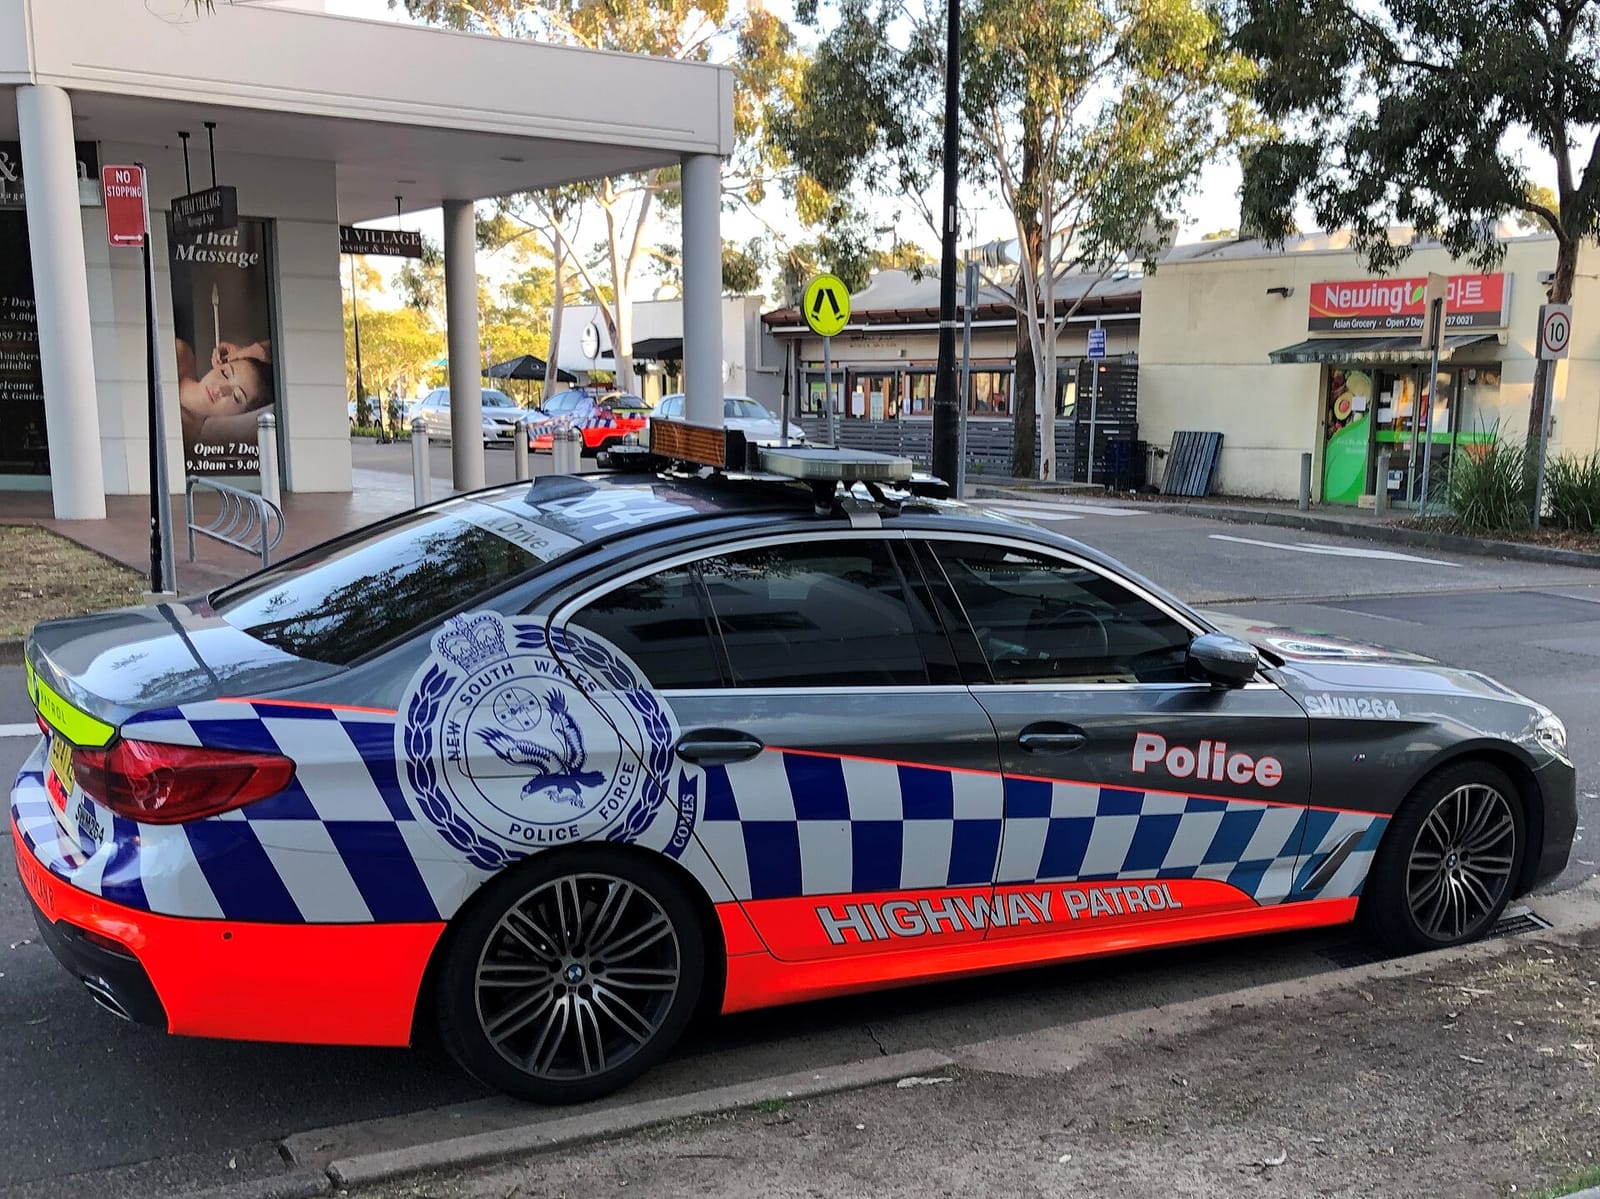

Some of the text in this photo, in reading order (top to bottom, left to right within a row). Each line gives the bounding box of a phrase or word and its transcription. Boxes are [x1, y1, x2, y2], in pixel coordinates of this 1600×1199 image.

[115, 170, 131, 184] NO
[106, 185, 142, 198] STOPPING
[355, 229, 420, 246] VILLAGE
[175, 244, 259, 269] Massage
[372, 244, 380, 254] &
[383, 244, 400, 255] Spa
[1333, 317, 1351, 329] Asian
[1351, 316, 1377, 331] Grocery
[1386, 316, 1405, 330] Open
[1405, 317, 1411, 327] 7
[1410, 315, 1425, 329] Day
[1550, 322, 1565, 342] 10
[194, 442, 260, 457] Open 7 Day
[186, 460, 226, 472] 9.30am
[498, 521, 550, 550] Drive
[447, 659, 598, 762] NEW SOUTH WALES
[1304, 692, 1401, 719] SWM264
[1131, 731, 1284, 788] Police
[598, 760, 636, 821] FORCE
[672, 793, 695, 848] COMES
[508, 822, 581, 842] POLICE
[816, 881, 1183, 946] HIGHWAY PATROL
